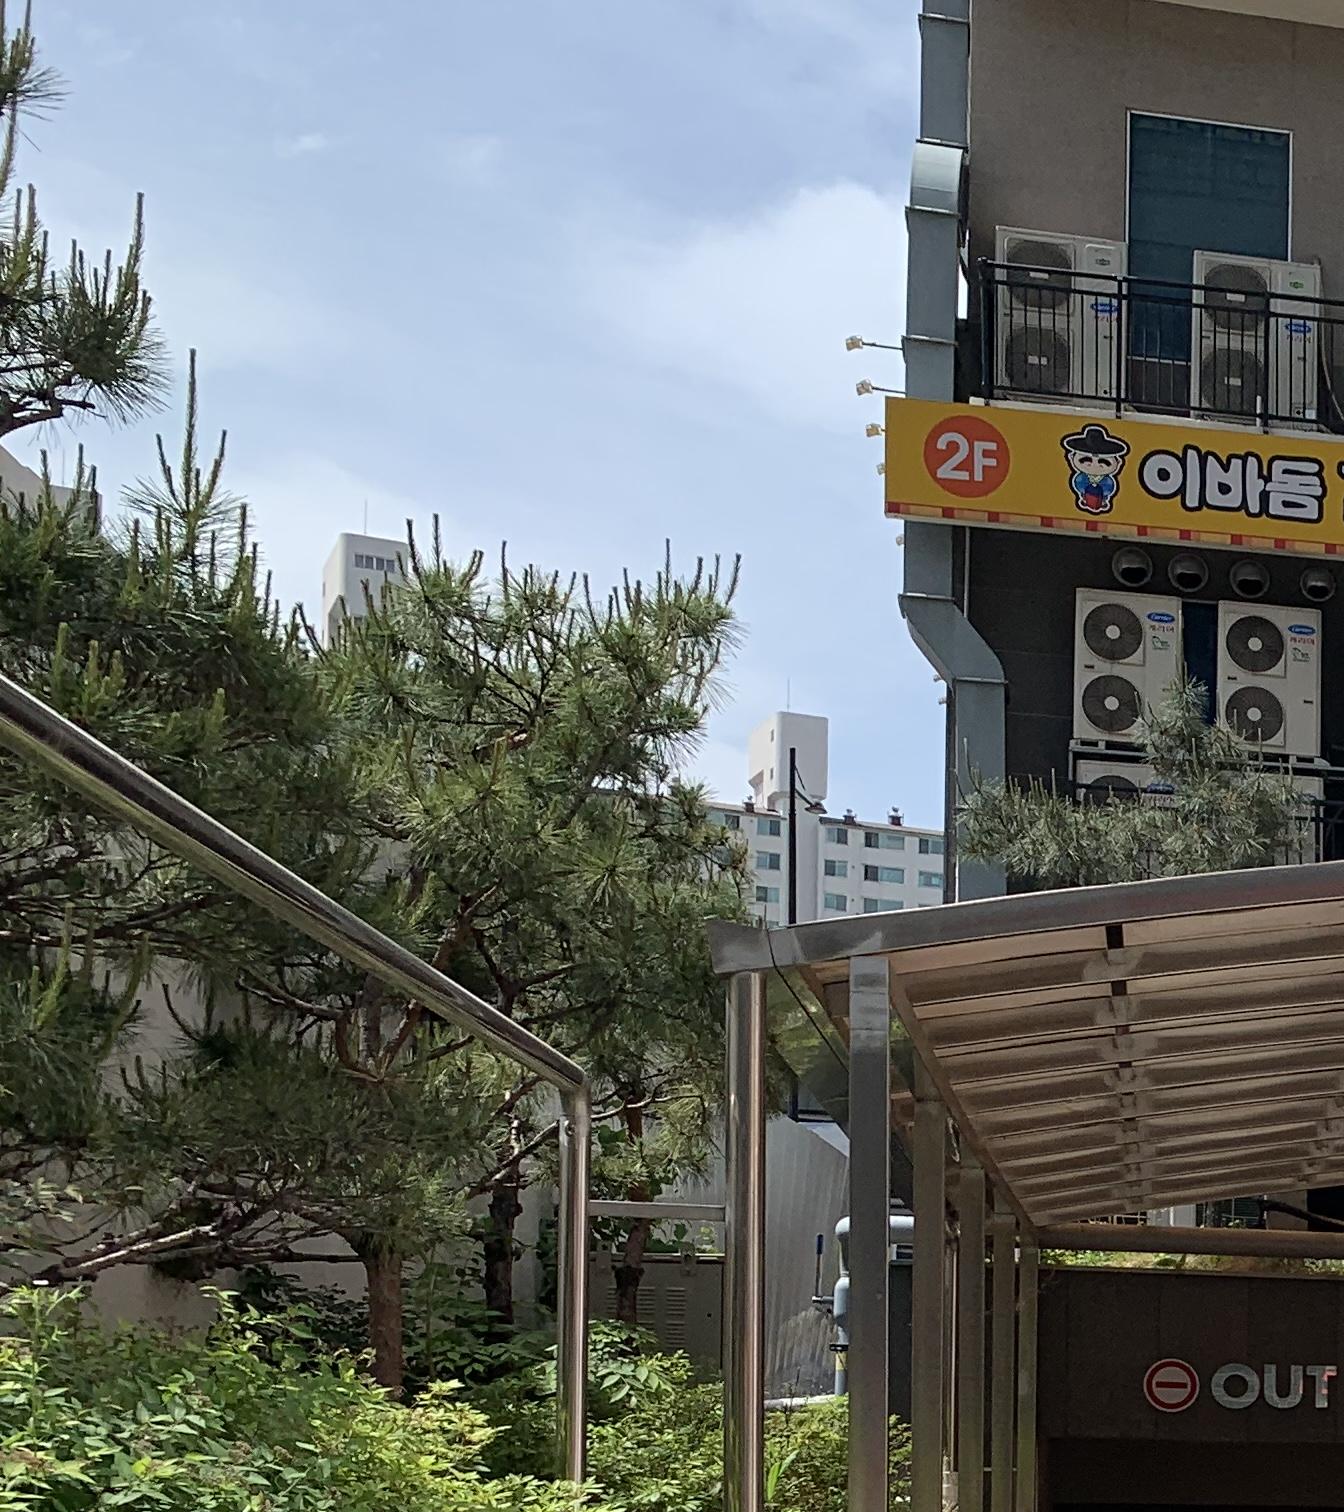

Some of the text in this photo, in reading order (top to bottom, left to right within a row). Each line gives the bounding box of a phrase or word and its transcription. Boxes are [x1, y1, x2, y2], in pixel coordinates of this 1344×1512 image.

[935, 431, 998, 482] 2F
[1140, 445, 1323, 522] 이바돔
[1210, 1362, 1338, 1410] OUT
